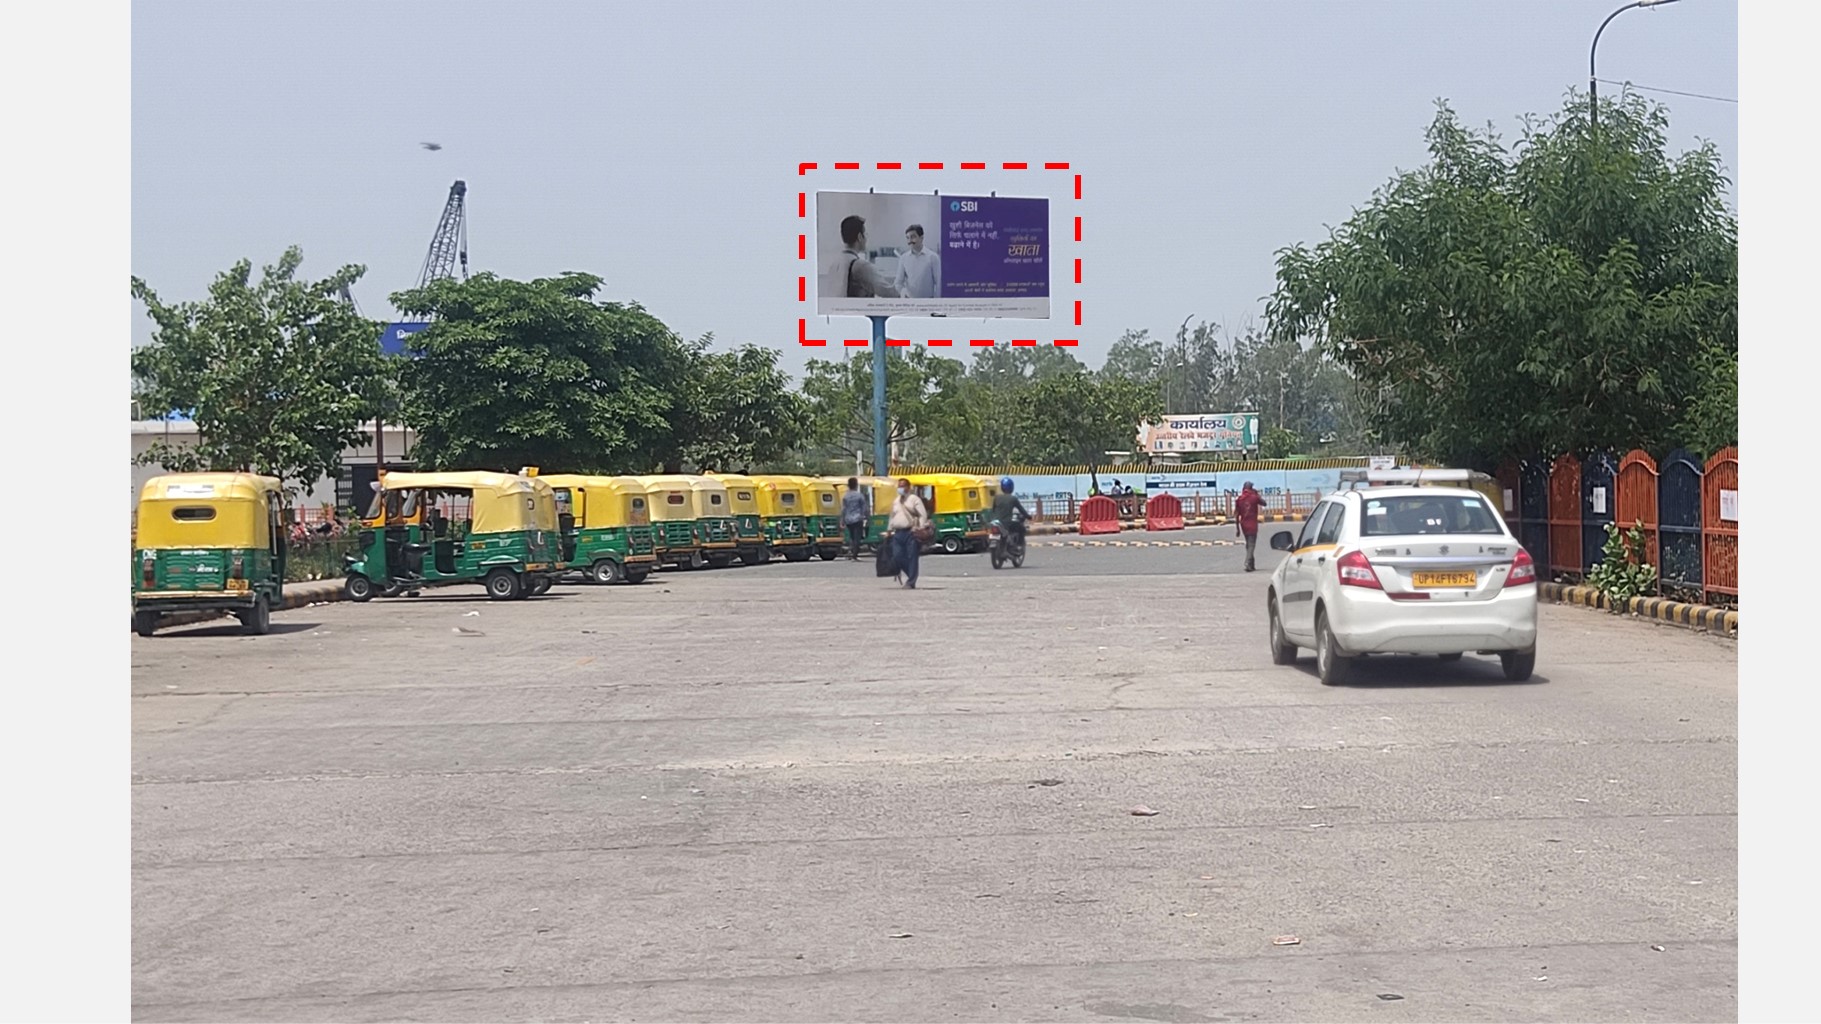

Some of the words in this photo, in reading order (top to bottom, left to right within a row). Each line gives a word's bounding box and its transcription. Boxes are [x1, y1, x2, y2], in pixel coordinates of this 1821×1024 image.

[961, 201, 978, 212] SBI
[1008, 244, 1041, 256] खाता
[1170, 416, 1227, 430] कार्यालय
